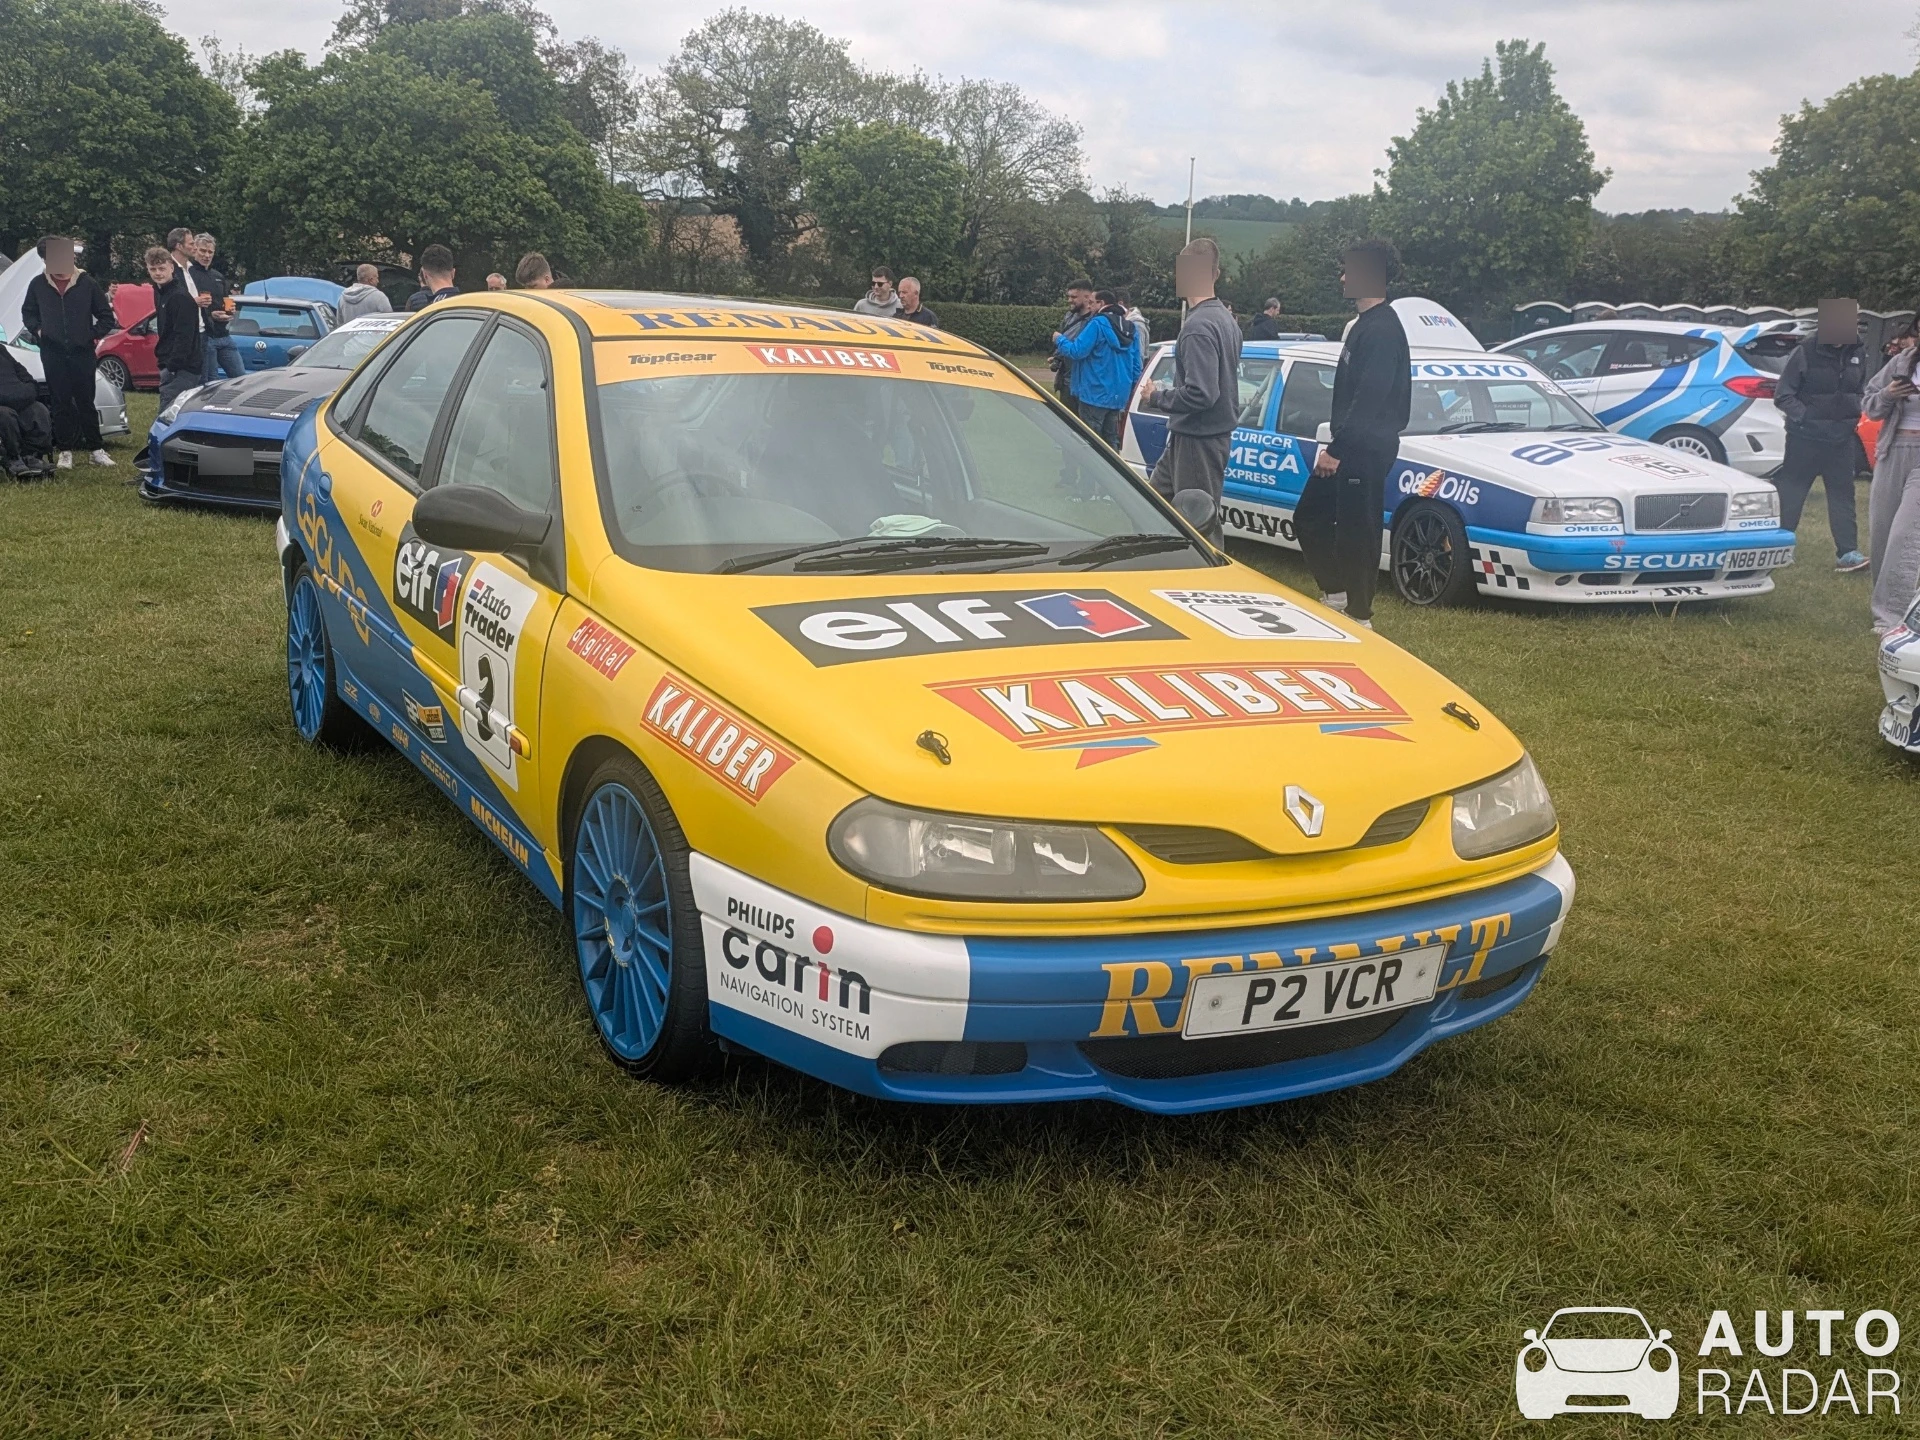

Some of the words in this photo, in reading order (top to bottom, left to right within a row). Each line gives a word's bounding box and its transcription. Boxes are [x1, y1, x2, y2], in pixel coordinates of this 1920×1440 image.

[622, 312, 950, 345] RENAULT
[759, 346, 893, 372] KALIBER
[1231, 431, 1293, 449] CURICOR
[1230, 447, 1299, 474] MEGA
[1399, 469, 1426, 495] Q8
[1439, 476, 1480, 505] Oils
[1565, 525, 1620, 533] OMEGA
[1738, 519, 1778, 528] OMEGA
[395, 542, 440, 612] elf
[1603, 552, 1727, 569] SECURIC
[1728, 553, 1755, 569] N88
[476, 585, 512, 621] Auto
[1171, 597, 1287, 607] Trader
[1188, 591, 1258, 601] Auto
[1654, 586, 1709, 597] TWR
[464, 602, 515, 653] Trader
[799, 598, 1028, 650] elf
[1237, 607, 1299, 635] 3
[572, 625, 628, 672] digital
[477, 652, 495, 742] 3
[980, 668, 1378, 735] KALIBER
[646, 684, 777, 795] KALIBER
[470, 795, 529, 870] MICHELIN
[727, 896, 795, 940] PHILIPS
[722, 925, 871, 1016] carin
[720, 971, 804, 1020] NAVIGATION
[811, 1008, 870, 1041] SYSTEM
[1241, 973, 1309, 1026] P2
[1322, 958, 1403, 1015] VCR
